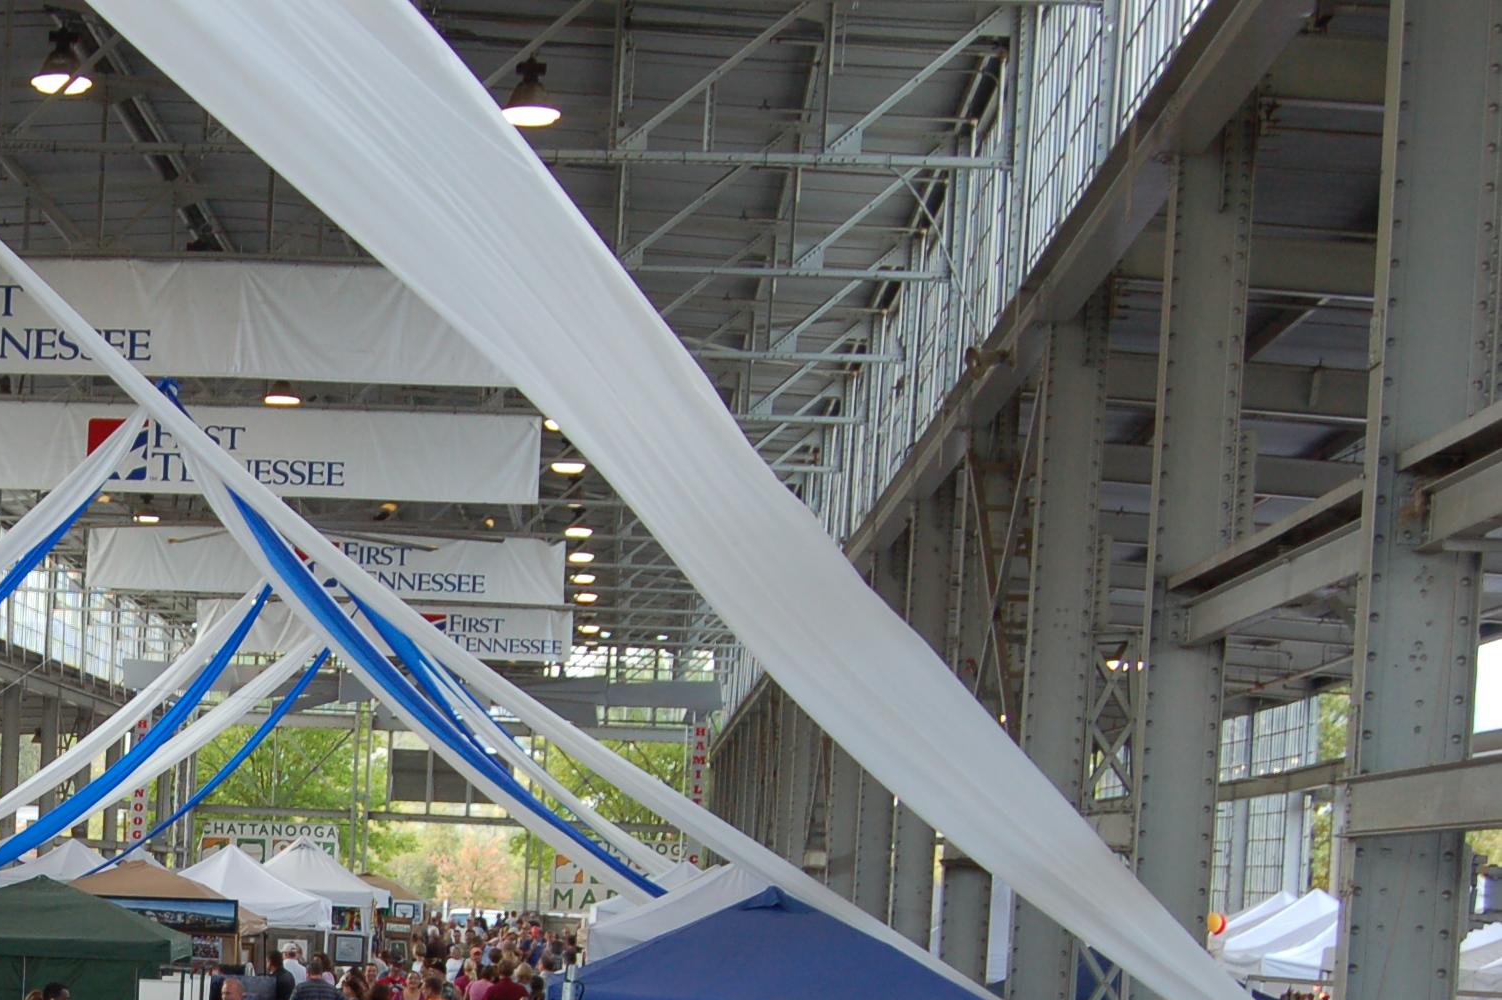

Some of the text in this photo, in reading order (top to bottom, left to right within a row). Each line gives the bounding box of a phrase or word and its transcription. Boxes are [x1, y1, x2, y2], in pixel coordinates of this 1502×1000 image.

[153, 418, 246, 450] FST
[151, 452, 345, 486] TESSEE
[344, 542, 413, 567] FIRST
[367, 570, 486, 594] NNESSEE
[449, 614, 505, 634] FIRST
[448, 633, 563, 655] TENNESSEE
[203, 821, 337, 839] CHATTANOOGA
